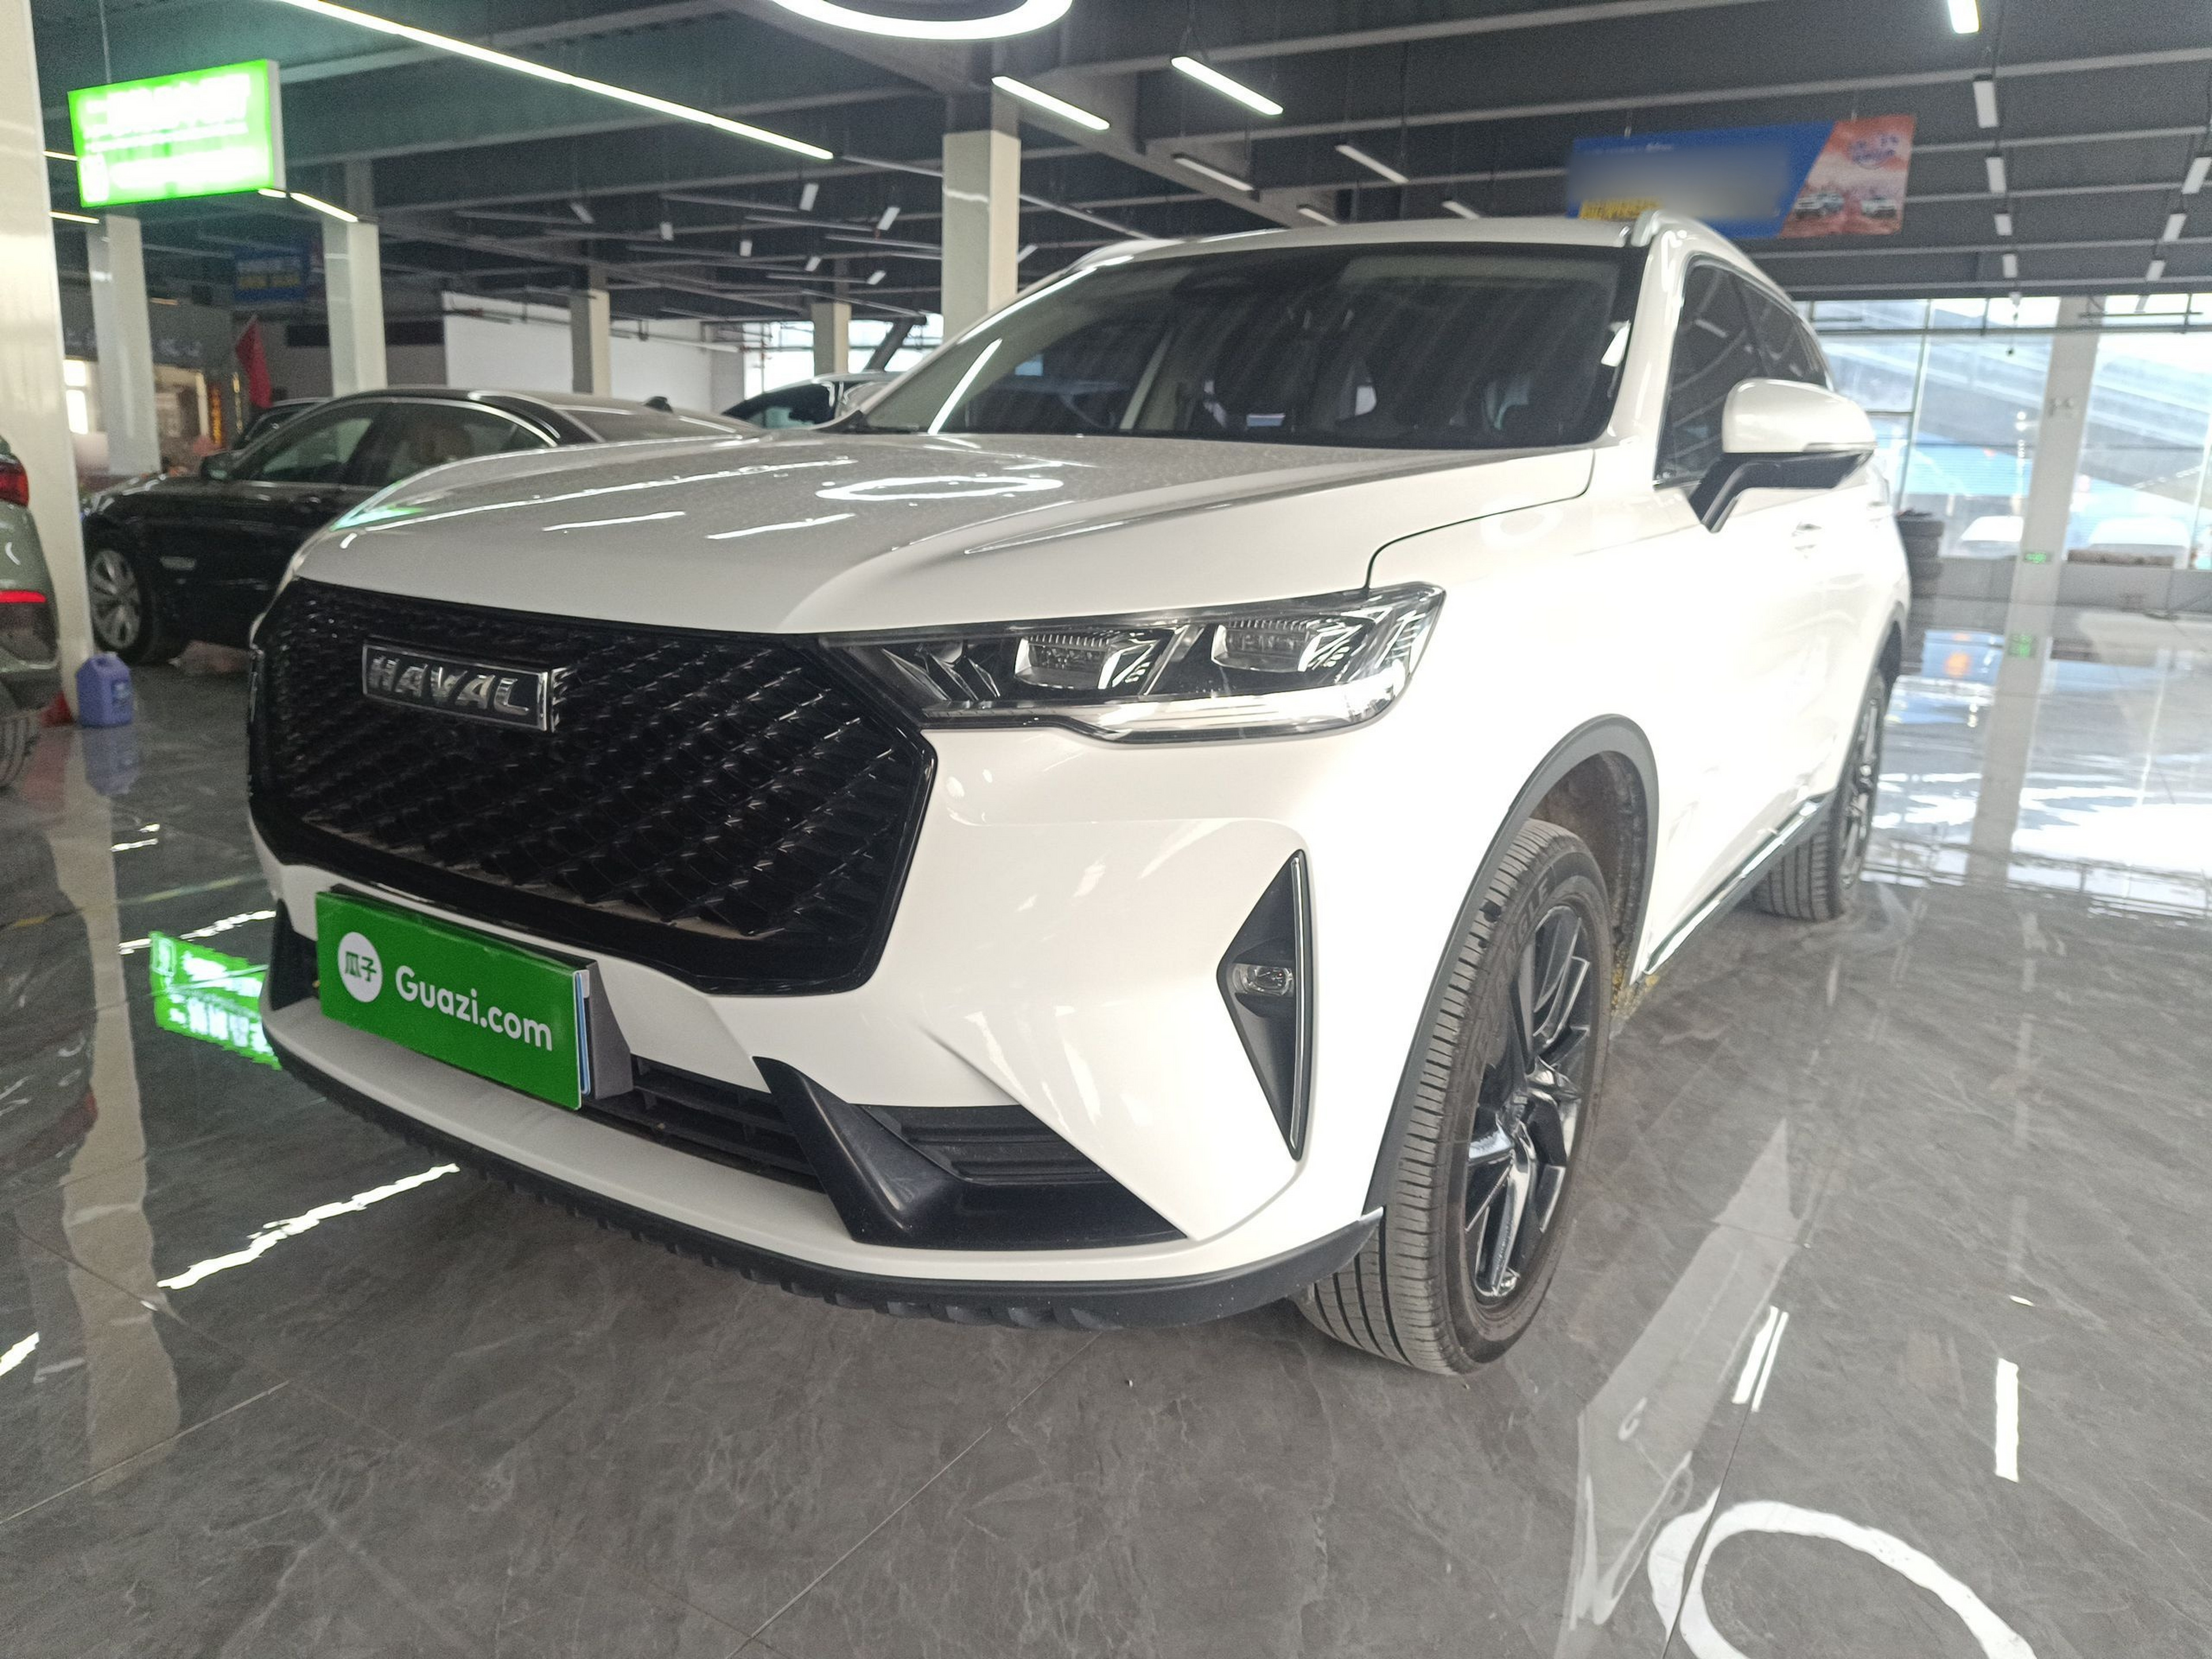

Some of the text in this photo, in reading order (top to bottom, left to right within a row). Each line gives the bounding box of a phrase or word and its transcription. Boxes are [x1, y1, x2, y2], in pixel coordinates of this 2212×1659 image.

[366, 656, 529, 716] HAVAL
[345, 950, 377, 982] 瓜子
[396, 965, 553, 1052] Guazi.com
